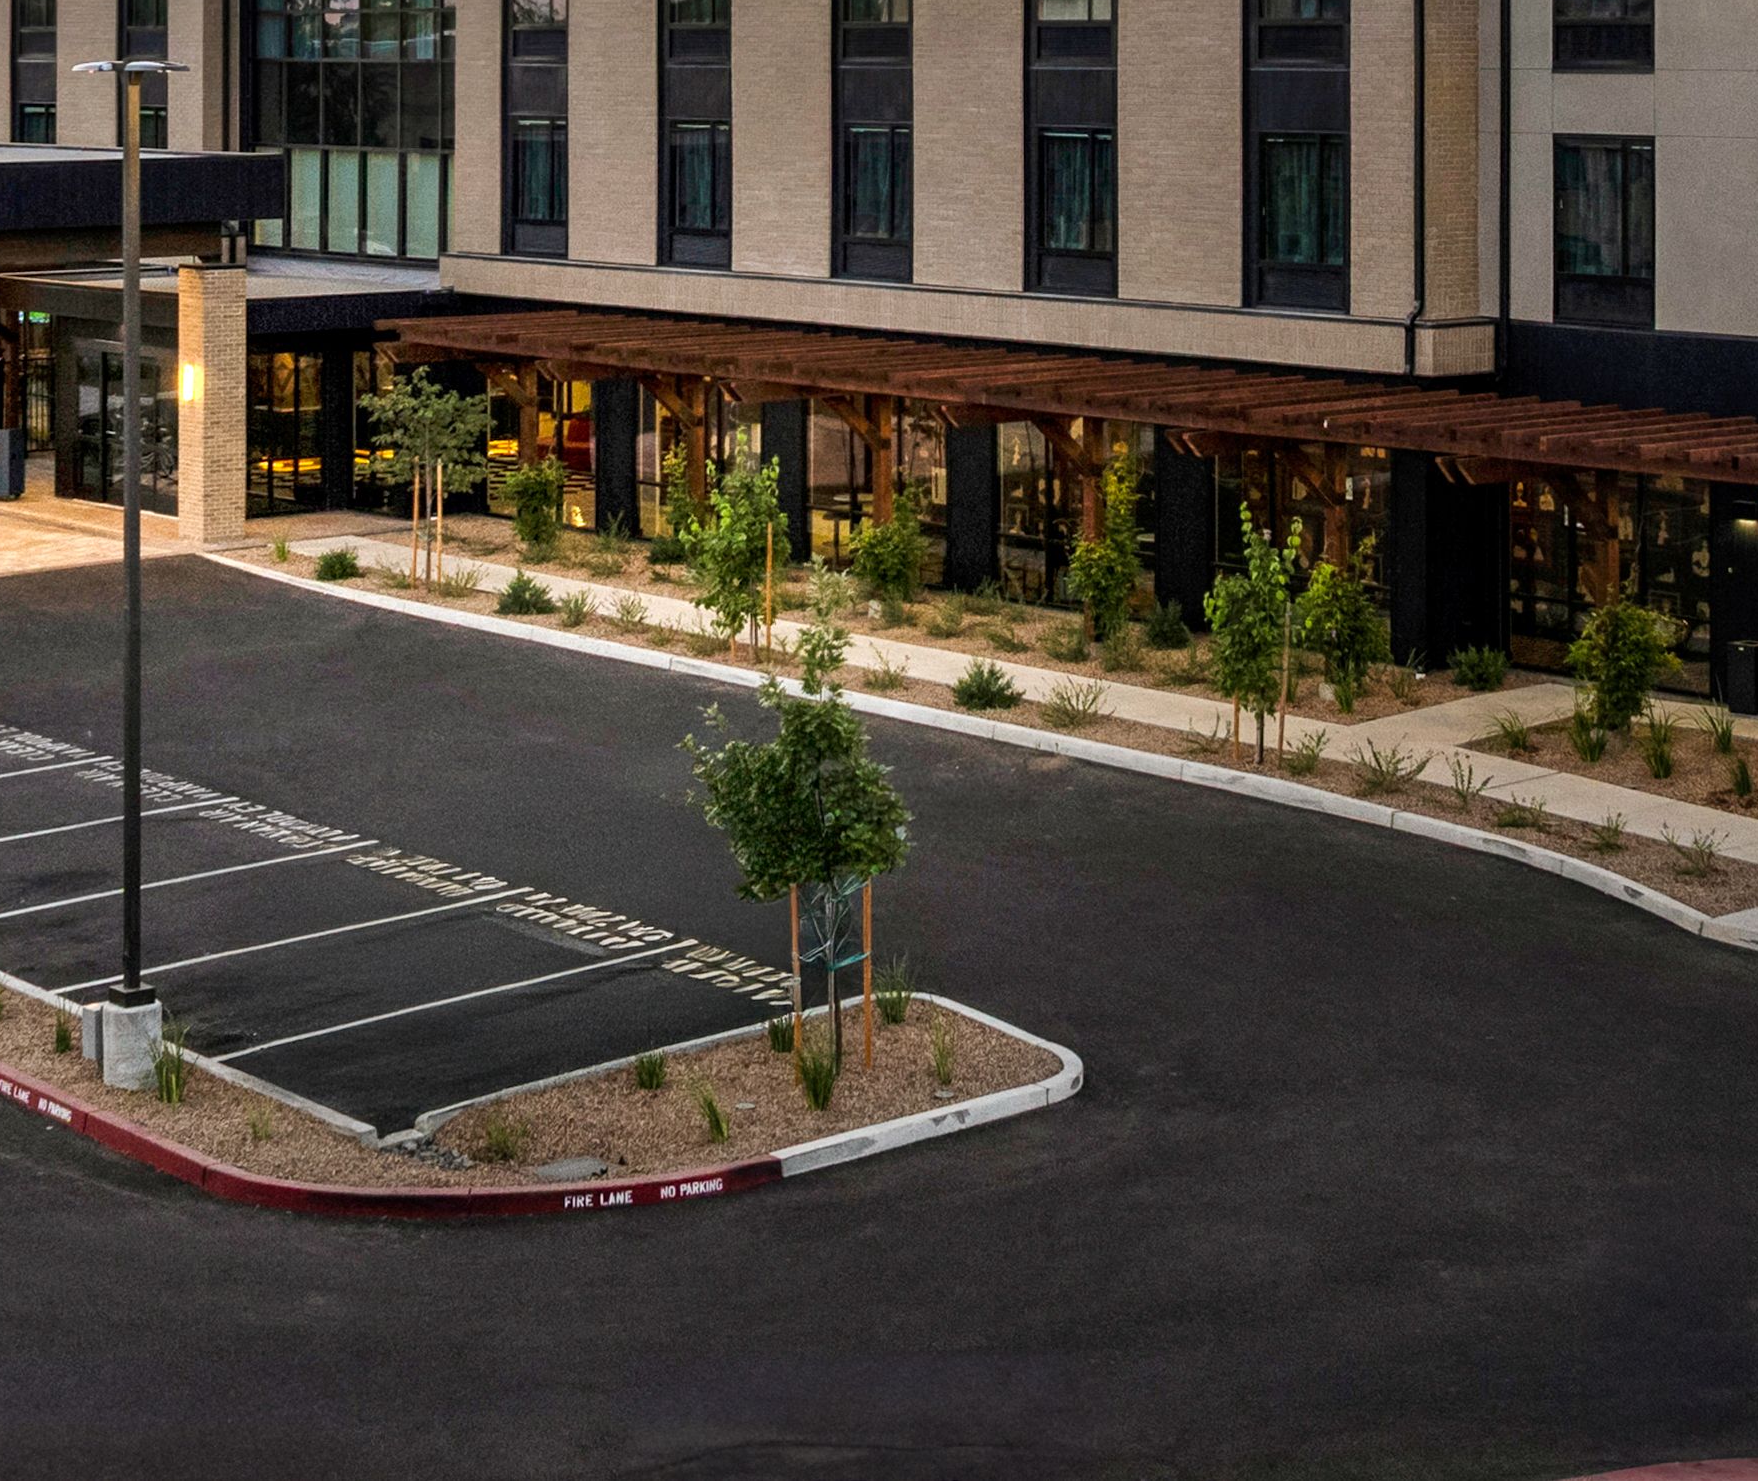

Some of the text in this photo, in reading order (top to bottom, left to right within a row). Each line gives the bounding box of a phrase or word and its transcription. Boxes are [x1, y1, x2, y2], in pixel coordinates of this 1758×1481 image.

[564, 1178, 723, 1208] FIRE LANE NO PARKING
